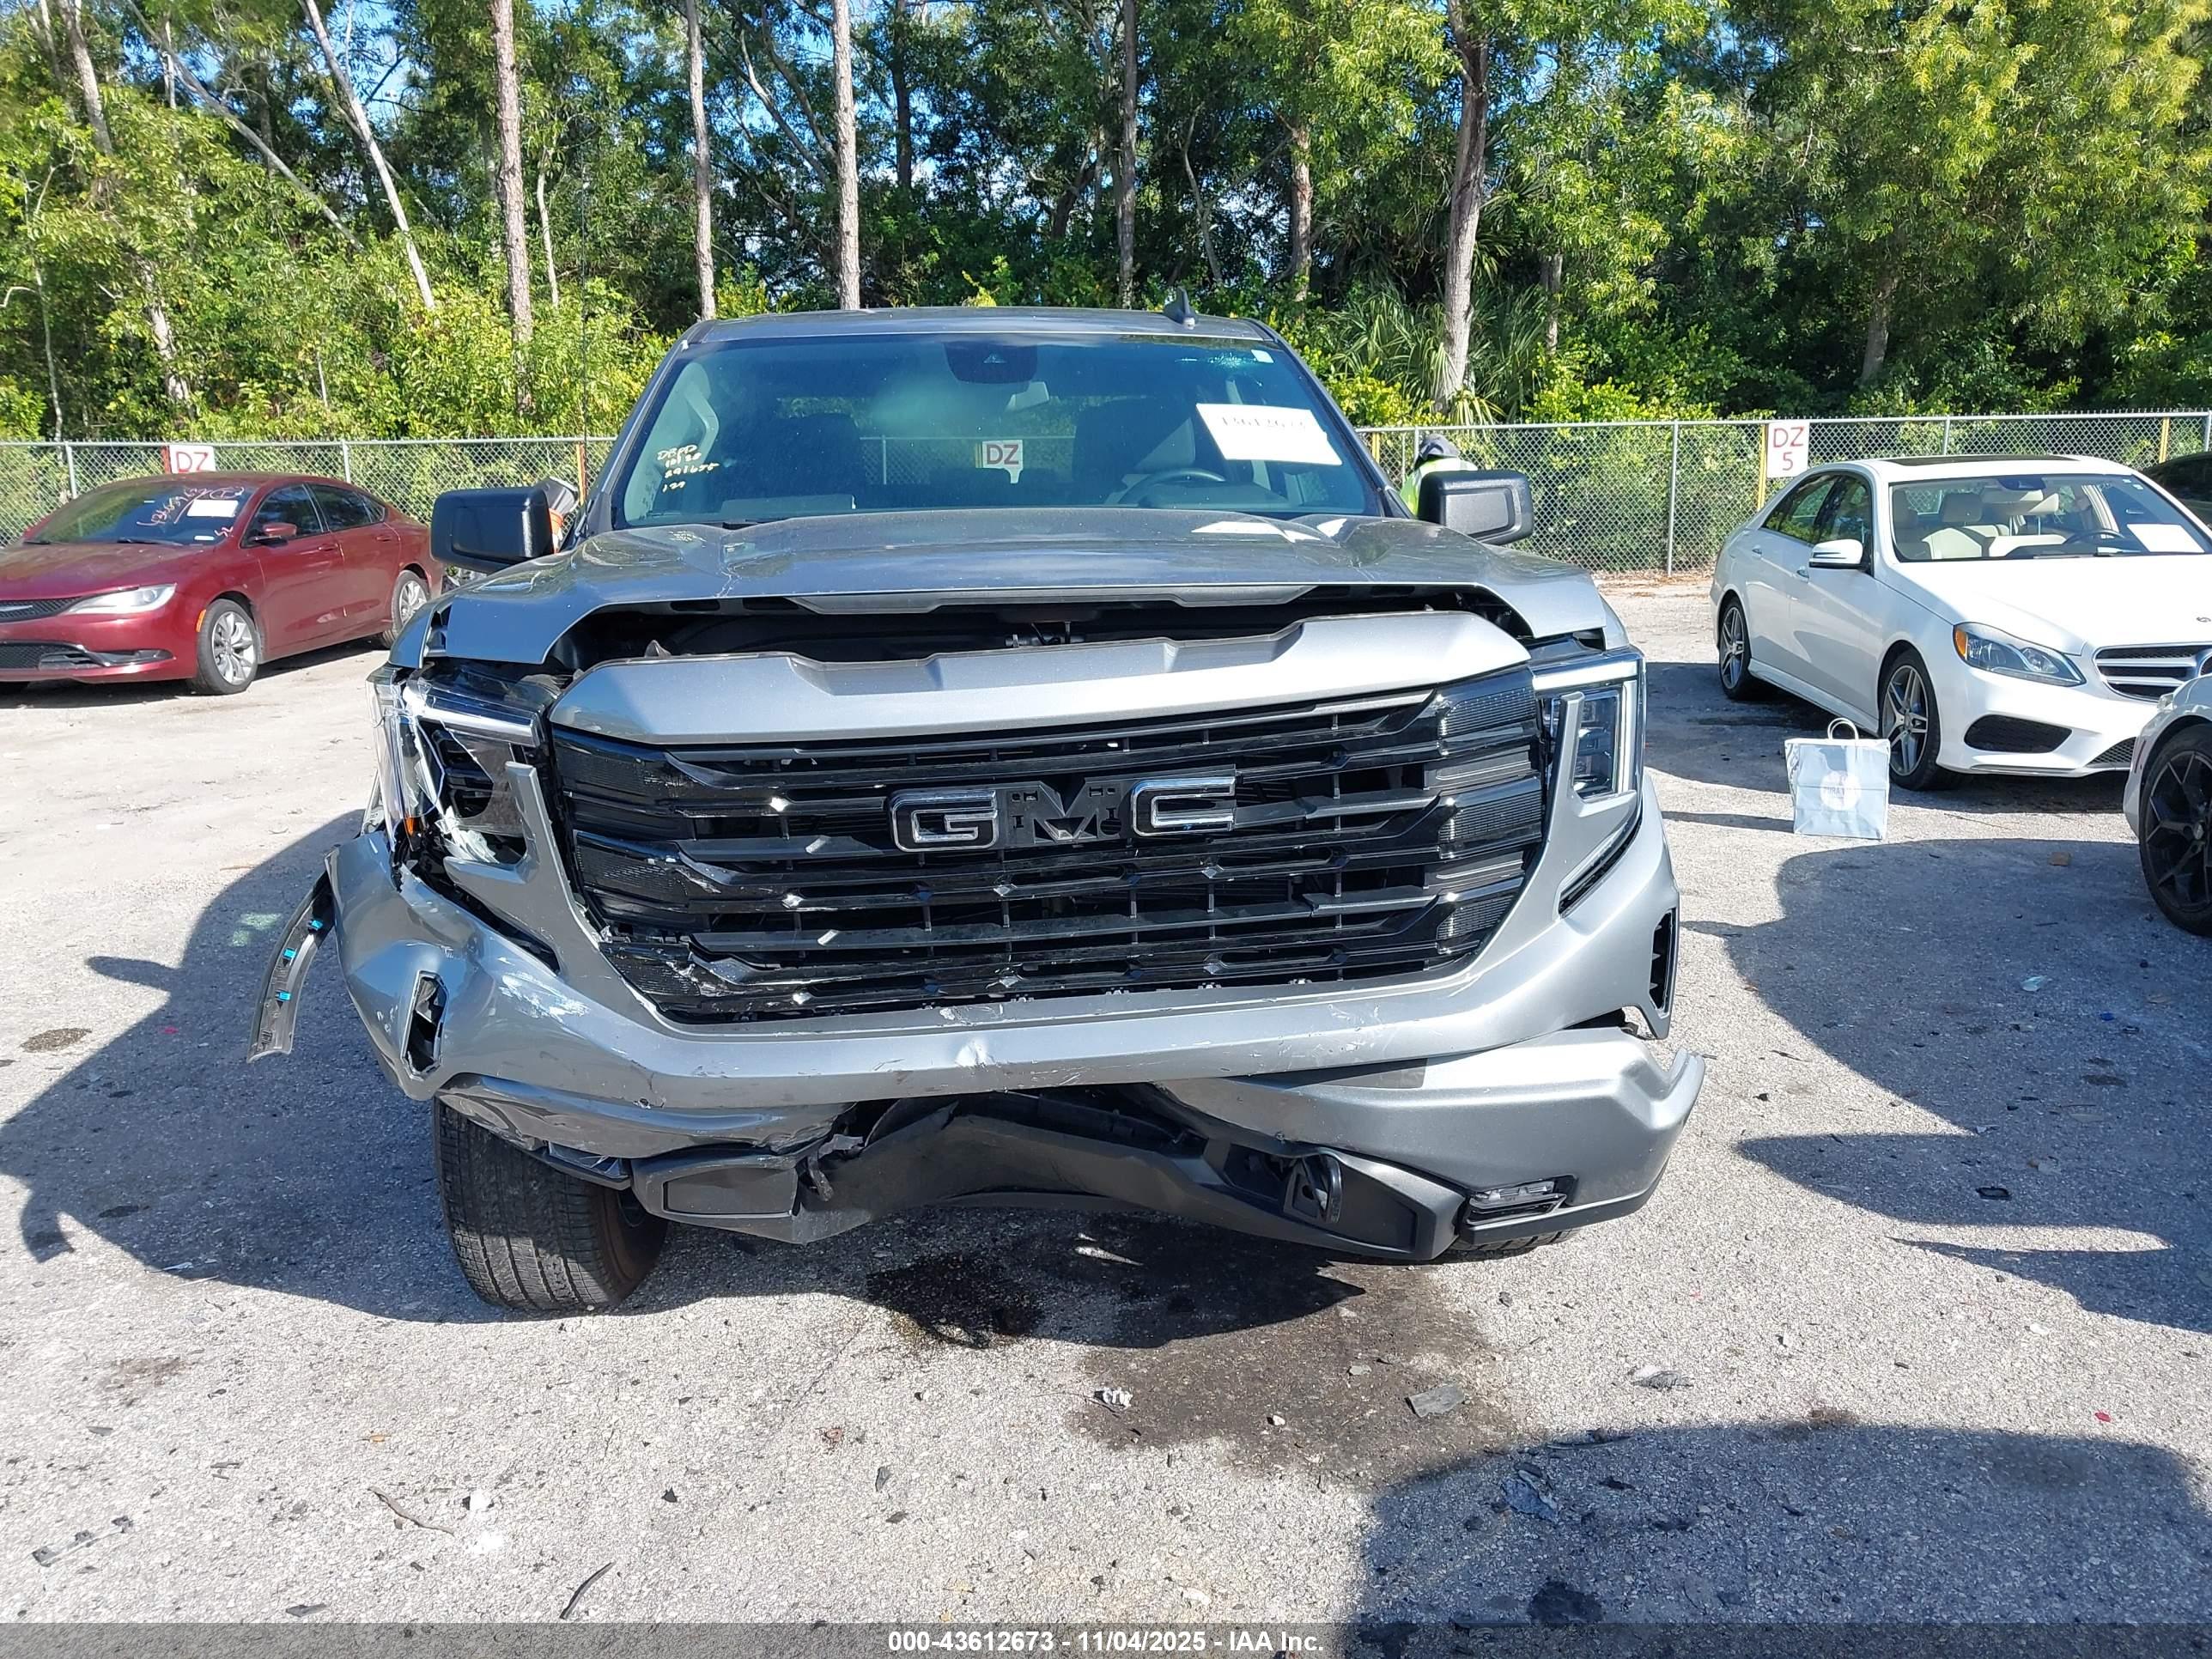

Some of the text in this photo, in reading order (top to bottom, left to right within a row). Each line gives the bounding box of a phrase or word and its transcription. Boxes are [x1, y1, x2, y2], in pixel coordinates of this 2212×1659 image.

[1772, 426, 1804, 447] DZ
[987, 444, 1019, 465] DZ
[1782, 452, 1794, 471] 5
[888, 775, 1236, 853] GMC
